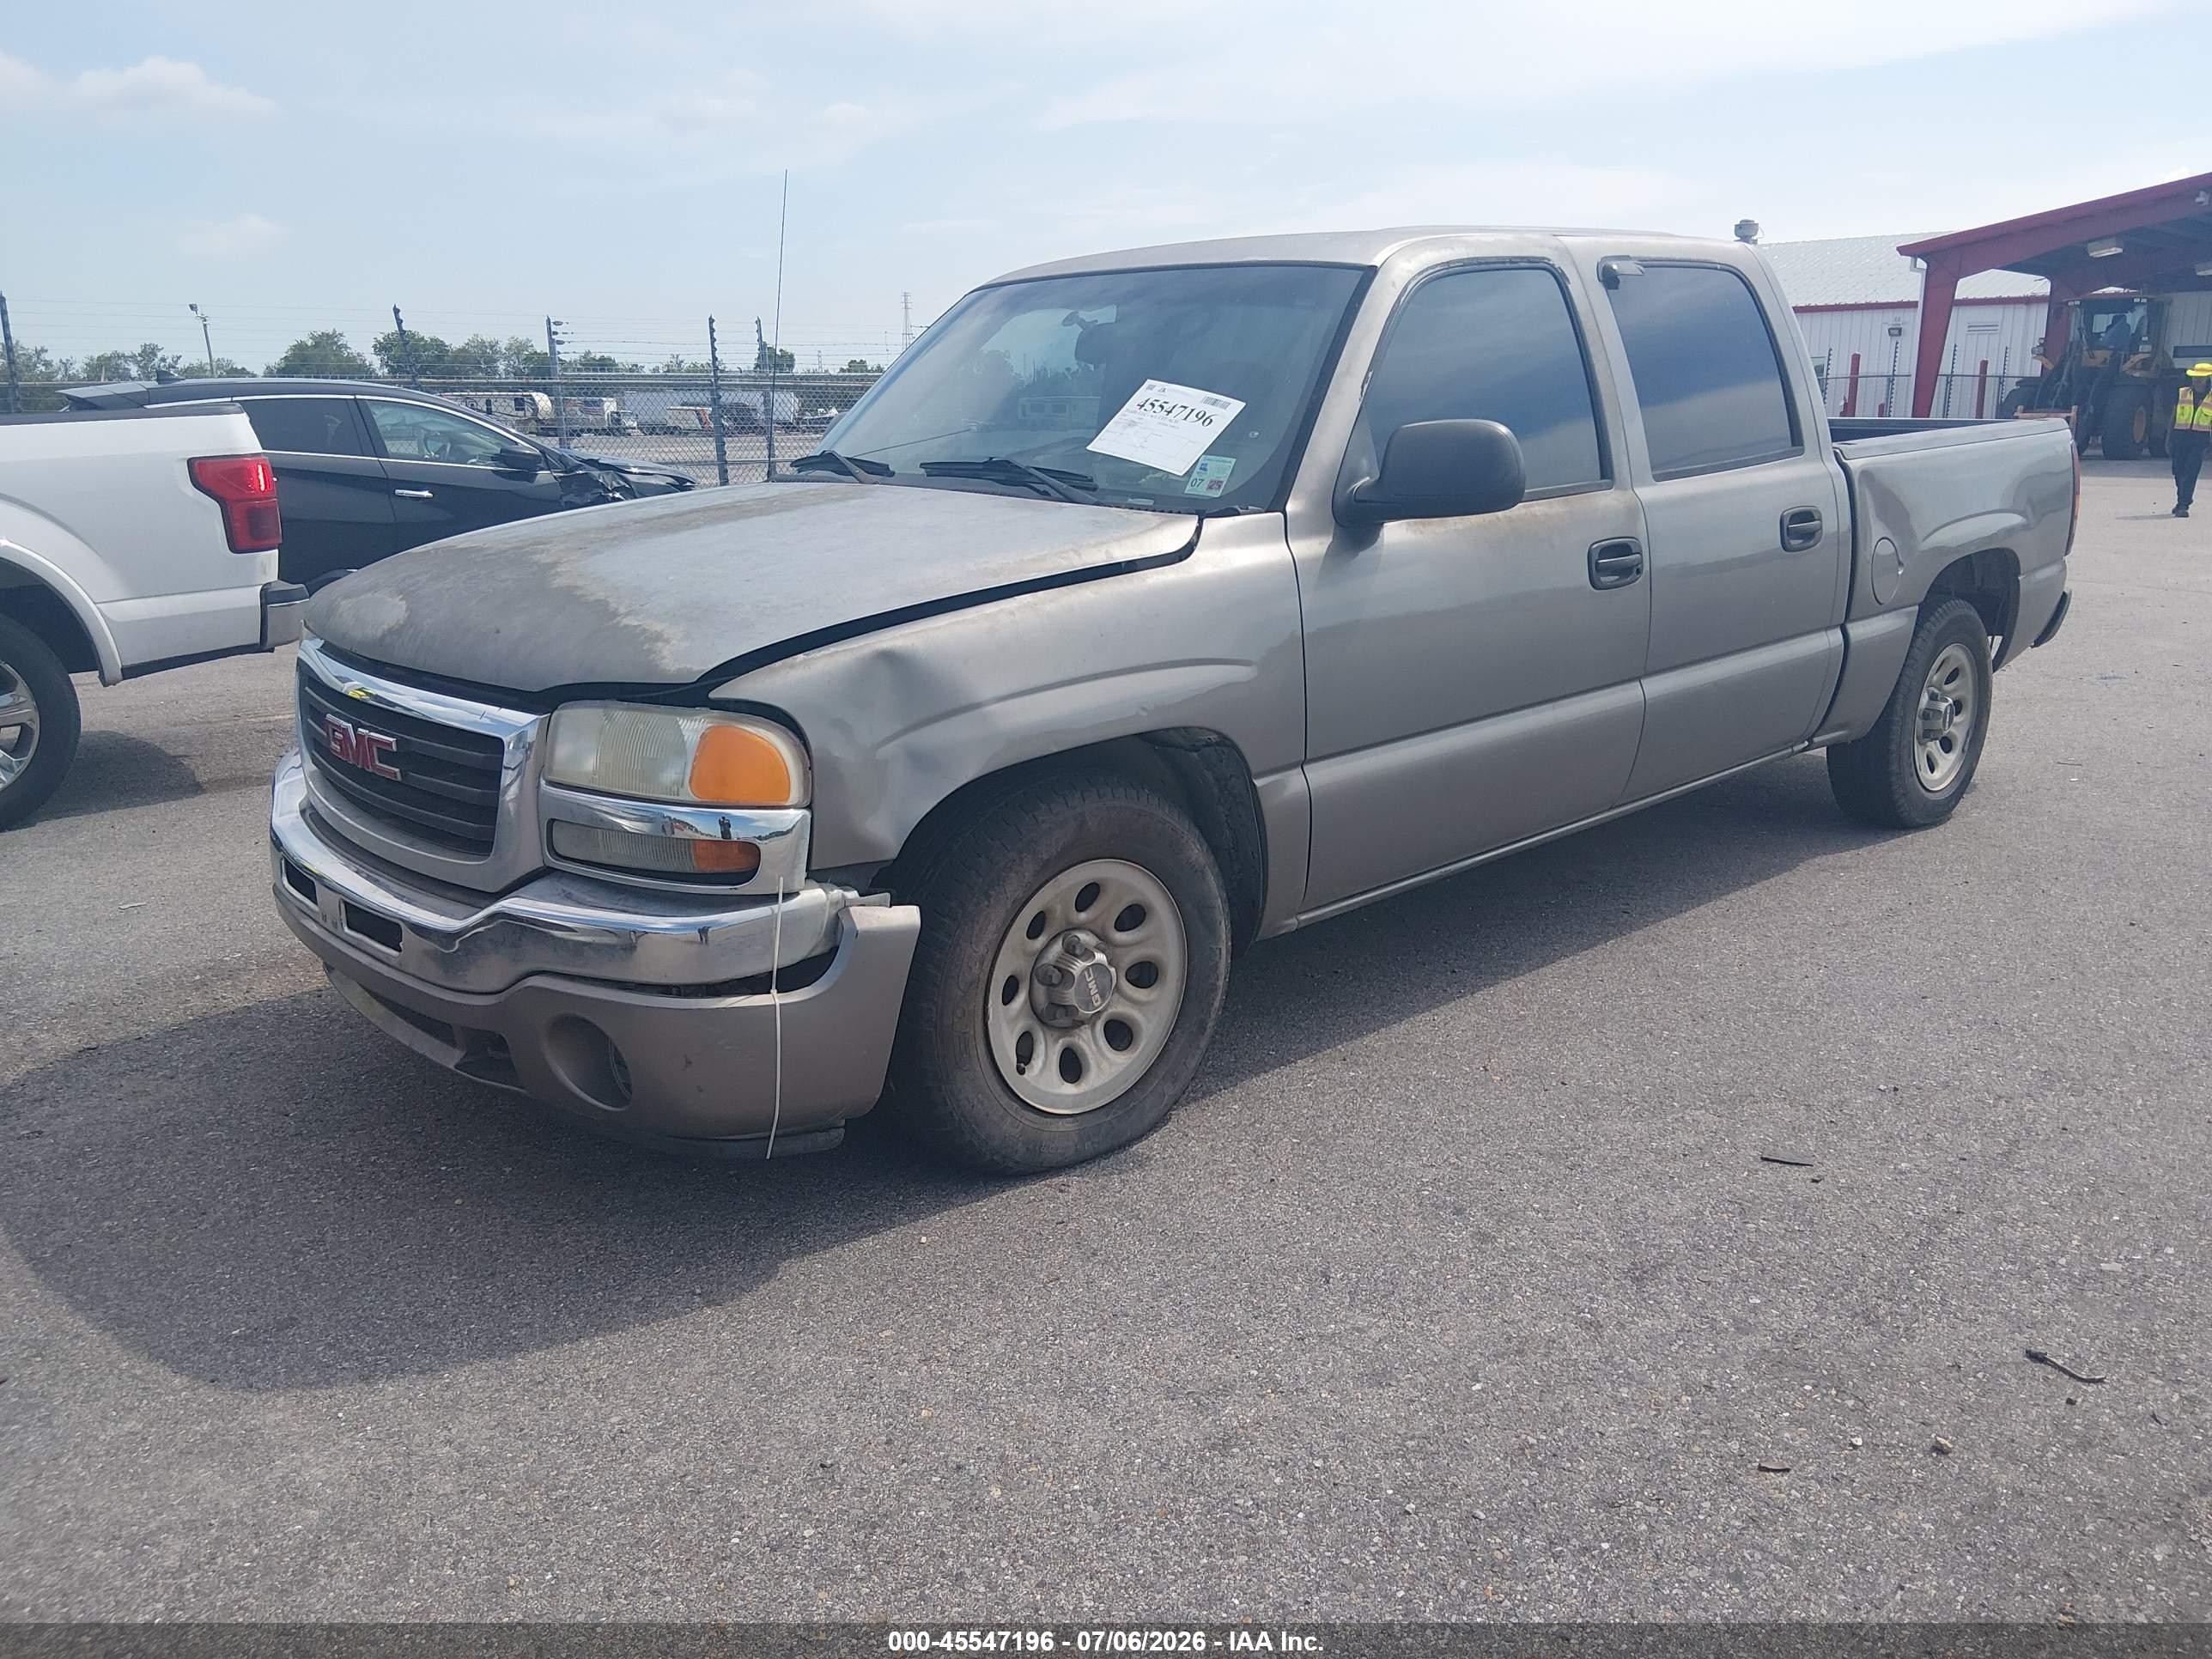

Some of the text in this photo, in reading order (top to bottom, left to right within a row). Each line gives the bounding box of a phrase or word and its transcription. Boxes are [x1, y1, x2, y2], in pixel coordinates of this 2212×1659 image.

[1137, 398, 1218, 428] 45547196
[1190, 477, 1205, 488] 07
[1208, 480, 1224, 489] 25
[325, 714, 402, 781] GMC
[1085, 967, 1102, 1007] GMC
